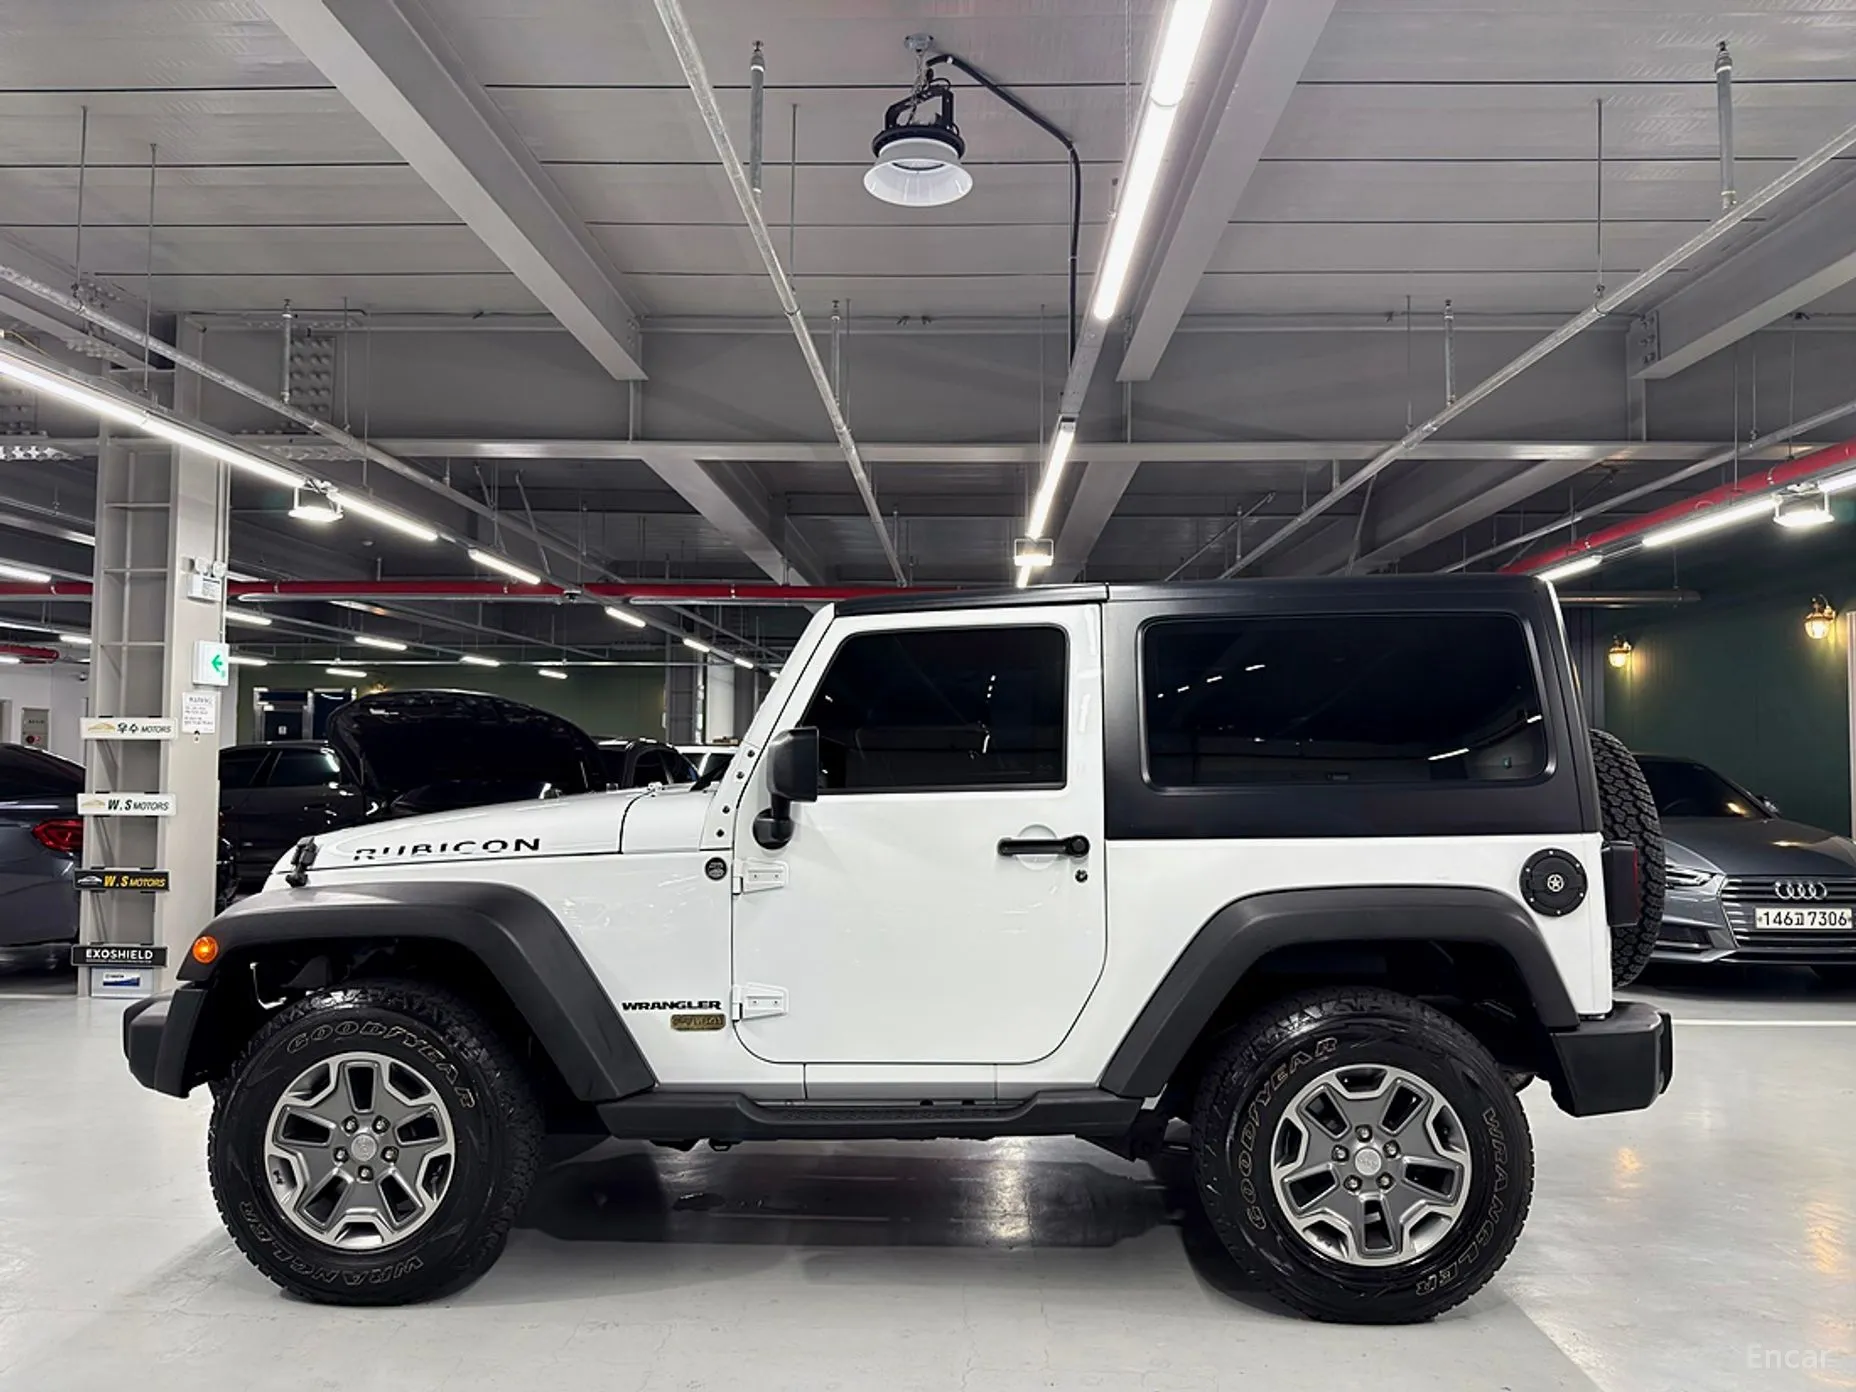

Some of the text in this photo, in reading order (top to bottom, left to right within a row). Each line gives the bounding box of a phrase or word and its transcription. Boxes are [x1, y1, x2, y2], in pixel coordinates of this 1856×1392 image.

[141, 725, 172, 734] MOTORS
[133, 801, 170, 811] MOTORS
[353, 838, 541, 861] RUBICON
[129, 878, 167, 888] MOTORS
[85, 948, 154, 960] EXOSHIELD
[621, 1000, 722, 1011] WRANGLER
[286, 1020, 476, 1109] GOODYEAR
[1238, 1036, 1338, 1231] GOODYEAR
[1415, 1106, 1510, 1296] WRANGLER
[239, 1200, 426, 1286] WRANGLER
